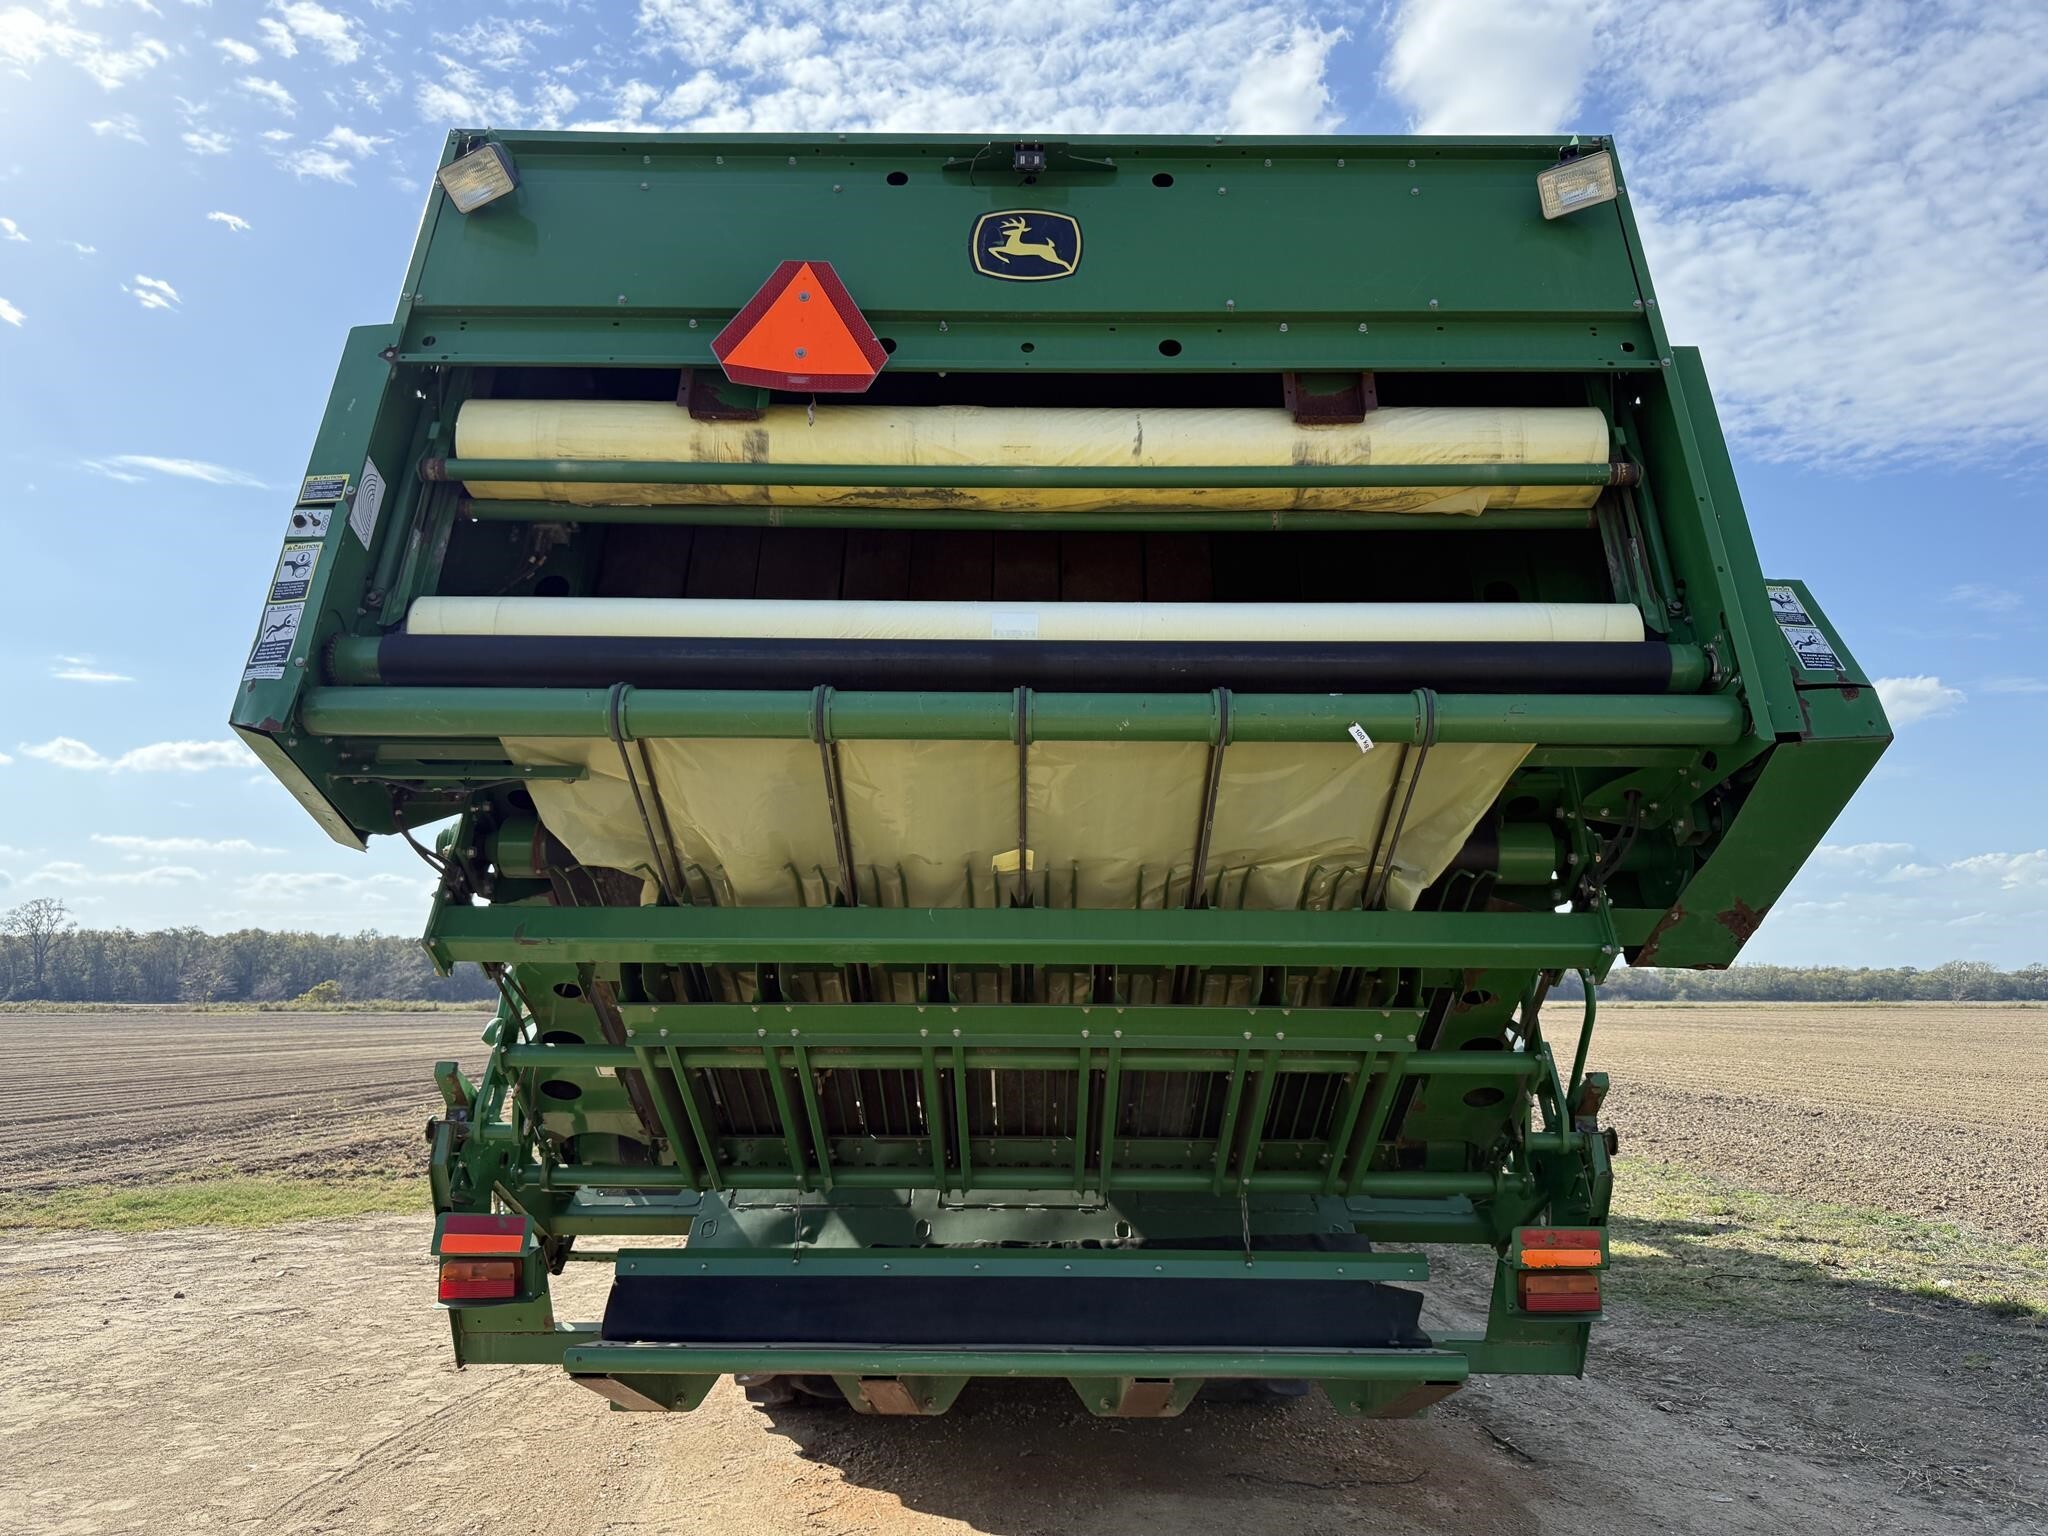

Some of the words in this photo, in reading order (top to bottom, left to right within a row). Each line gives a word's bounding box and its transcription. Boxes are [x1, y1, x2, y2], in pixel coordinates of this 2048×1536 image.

[293, 543, 320, 551] CAUTION
[1355, 729, 1365, 740] 100
[1363, 740, 1369, 749] kg
